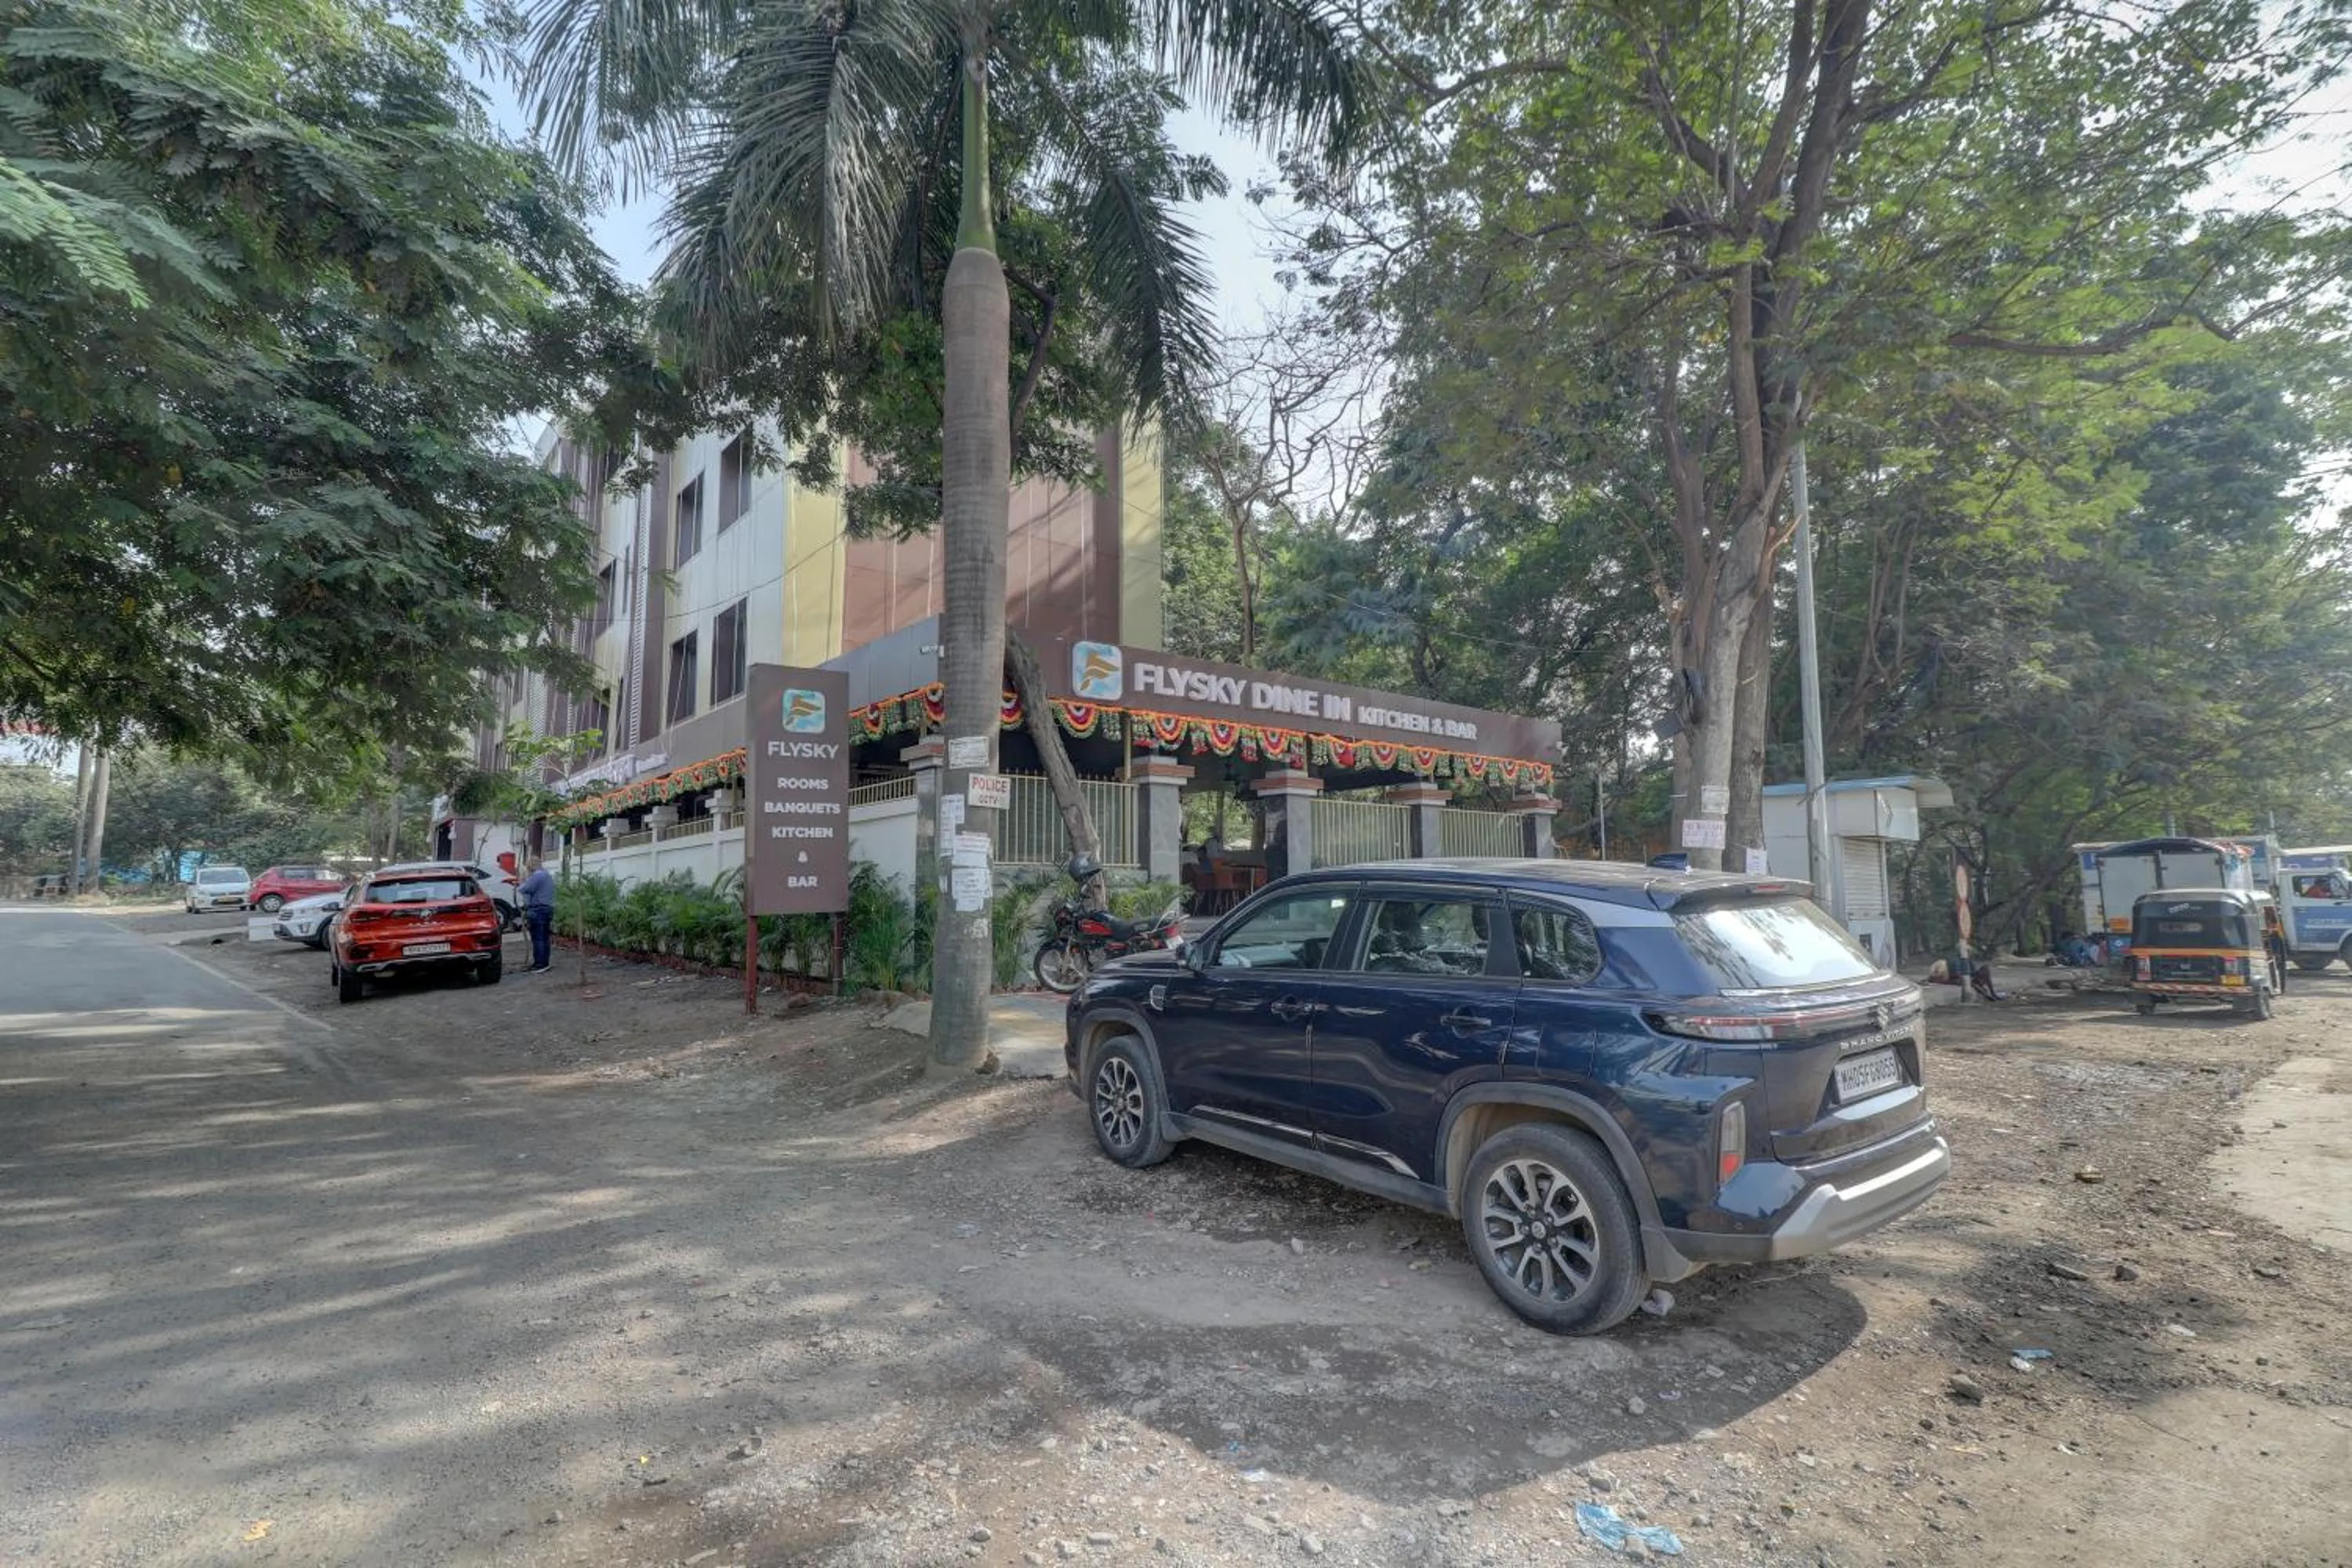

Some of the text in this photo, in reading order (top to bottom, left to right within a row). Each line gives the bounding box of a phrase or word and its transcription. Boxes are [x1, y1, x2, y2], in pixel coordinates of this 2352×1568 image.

[1134, 662, 1478, 741] FLYSKY DINE IN KITCHEN & BAR
[768, 741, 840, 759] FLYSKY
[777, 777, 829, 789] ROOMS
[971, 776, 1007, 793] POLICE
[764, 801, 840, 814] BANQUETS
[772, 827, 833, 838] KITCHEN
[798, 850, 808, 863] &
[787, 876, 818, 887] BAR
